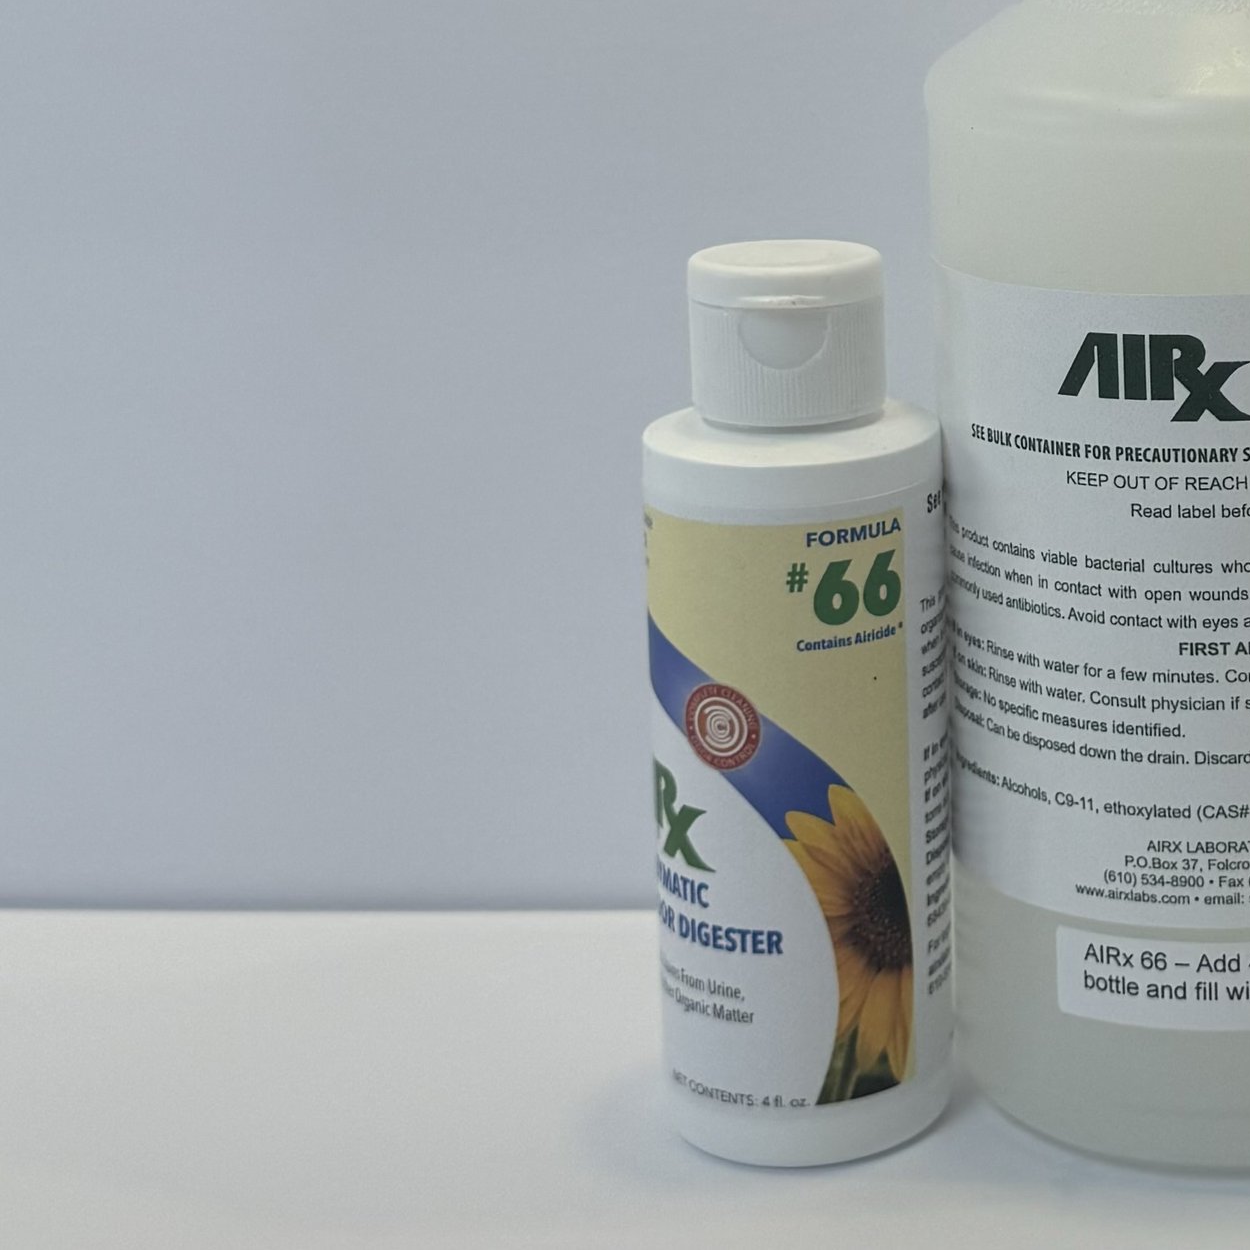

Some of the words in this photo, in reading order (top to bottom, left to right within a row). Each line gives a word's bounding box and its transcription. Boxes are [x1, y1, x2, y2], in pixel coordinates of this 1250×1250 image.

[972, 423, 985, 441] SEE
[987, 428, 1011, 447] BULK
[1015, 435, 1080, 457] CONTAINER
[1085, 444, 1111, 460] FOR
[1116, 446, 1238, 463] PRECAUTIONARY
[1067, 471, 1108, 487] KEEP
[1114, 475, 1150, 489] OUT
[1155, 476, 1179, 490] OF
[1185, 476, 1247, 490] REACH
[1131, 503, 1171, 518] Read
[1178, 505, 1215, 518] label
[807, 518, 901, 547] FORMULA
[962, 527, 989, 548] product
[993, 540, 1035, 559] contains
[1041, 551, 1077, 566] viable
[1085, 555, 1144, 572] bacterial
[1153, 560, 1213, 574] cultures
[968, 556, 1000, 577] infection
[1005, 569, 1032, 586] when
[1038, 574, 1048, 589] in
[1055, 581, 1102, 596] contact
[1108, 586, 1137, 599] with
[1145, 590, 1181, 604] open
[982, 589, 1003, 605] used
[1006, 597, 1065, 619] antibiotics.
[1068, 607, 1105, 624] Avoid
[1110, 615, 1162, 628] contact
[1167, 615, 1197, 629] with
[1203, 618, 1238, 632] eyes
[797, 636, 852, 652] Contains
[964, 631, 984, 650] eyes:
[987, 640, 1014, 661] Rinse
[1017, 653, 1040, 667] with
[1044, 659, 1079, 674] water
[1084, 663, 1102, 677] for
[1107, 669, 1115, 679] a
[1121, 667, 1147, 681] few
[1153, 671, 1219, 683] minutes.
[1179, 642, 1230, 656] FIRST
[967, 658, 986, 677] skin:
[989, 666, 1016, 688] Rinse
[1019, 679, 1042, 695] with
[1046, 686, 1085, 703] water.
[1090, 691, 1146, 709] Consult
[1152, 696, 1225, 713] physician
[1231, 696, 1240, 710] if
[984, 690, 996, 707] No
[999, 700, 1038, 720] specific
[1042, 712, 1107, 732] measures
[1113, 720, 1185, 737] identified.
[987, 718, 1005, 736] Can
[1007, 726, 1020, 741] be
[1023, 731, 1075, 755] disposed
[1079, 744, 1116, 760] down
[1121, 748, 1143, 762] the
[1148, 750, 1189, 764] drain.
[1001, 776, 1051, 805] Alcohols,
[1055, 792, 1099, 814] C9-11,
[1104, 801, 1191, 820] ethoxylated
[1197, 805, 1249, 822] (CAS#
[1147, 840, 1182, 853] AIRX
[1125, 855, 1178, 870] P.O.Box
[1182, 859, 1202, 872] 37,
[1104, 870, 1137, 887] (610)
[1141, 874, 1204, 887] 534-8900
[1219, 876, 1244, 888] Fax
[1075, 884, 1190, 905] www.airxlabs.com
[1204, 892, 1244, 905] email:
[679, 914, 783, 955] DIGESTER
[1084, 943, 1134, 968] AIRx
[1141, 951, 1167, 971] 66
[1196, 954, 1240, 973] Add
[707, 979, 744, 1001] Urine,
[1084, 970, 1139, 996] bottle
[1147, 981, 1186, 1000] and
[1195, 982, 1218, 1001] fill
[712, 1003, 754, 1023] Matter
[688, 1079, 758, 1107] CONTENTS:
[762, 1096, 770, 1107] 4
[773, 1095, 785, 1108] fl.
[789, 1098, 810, 1108] oz.
